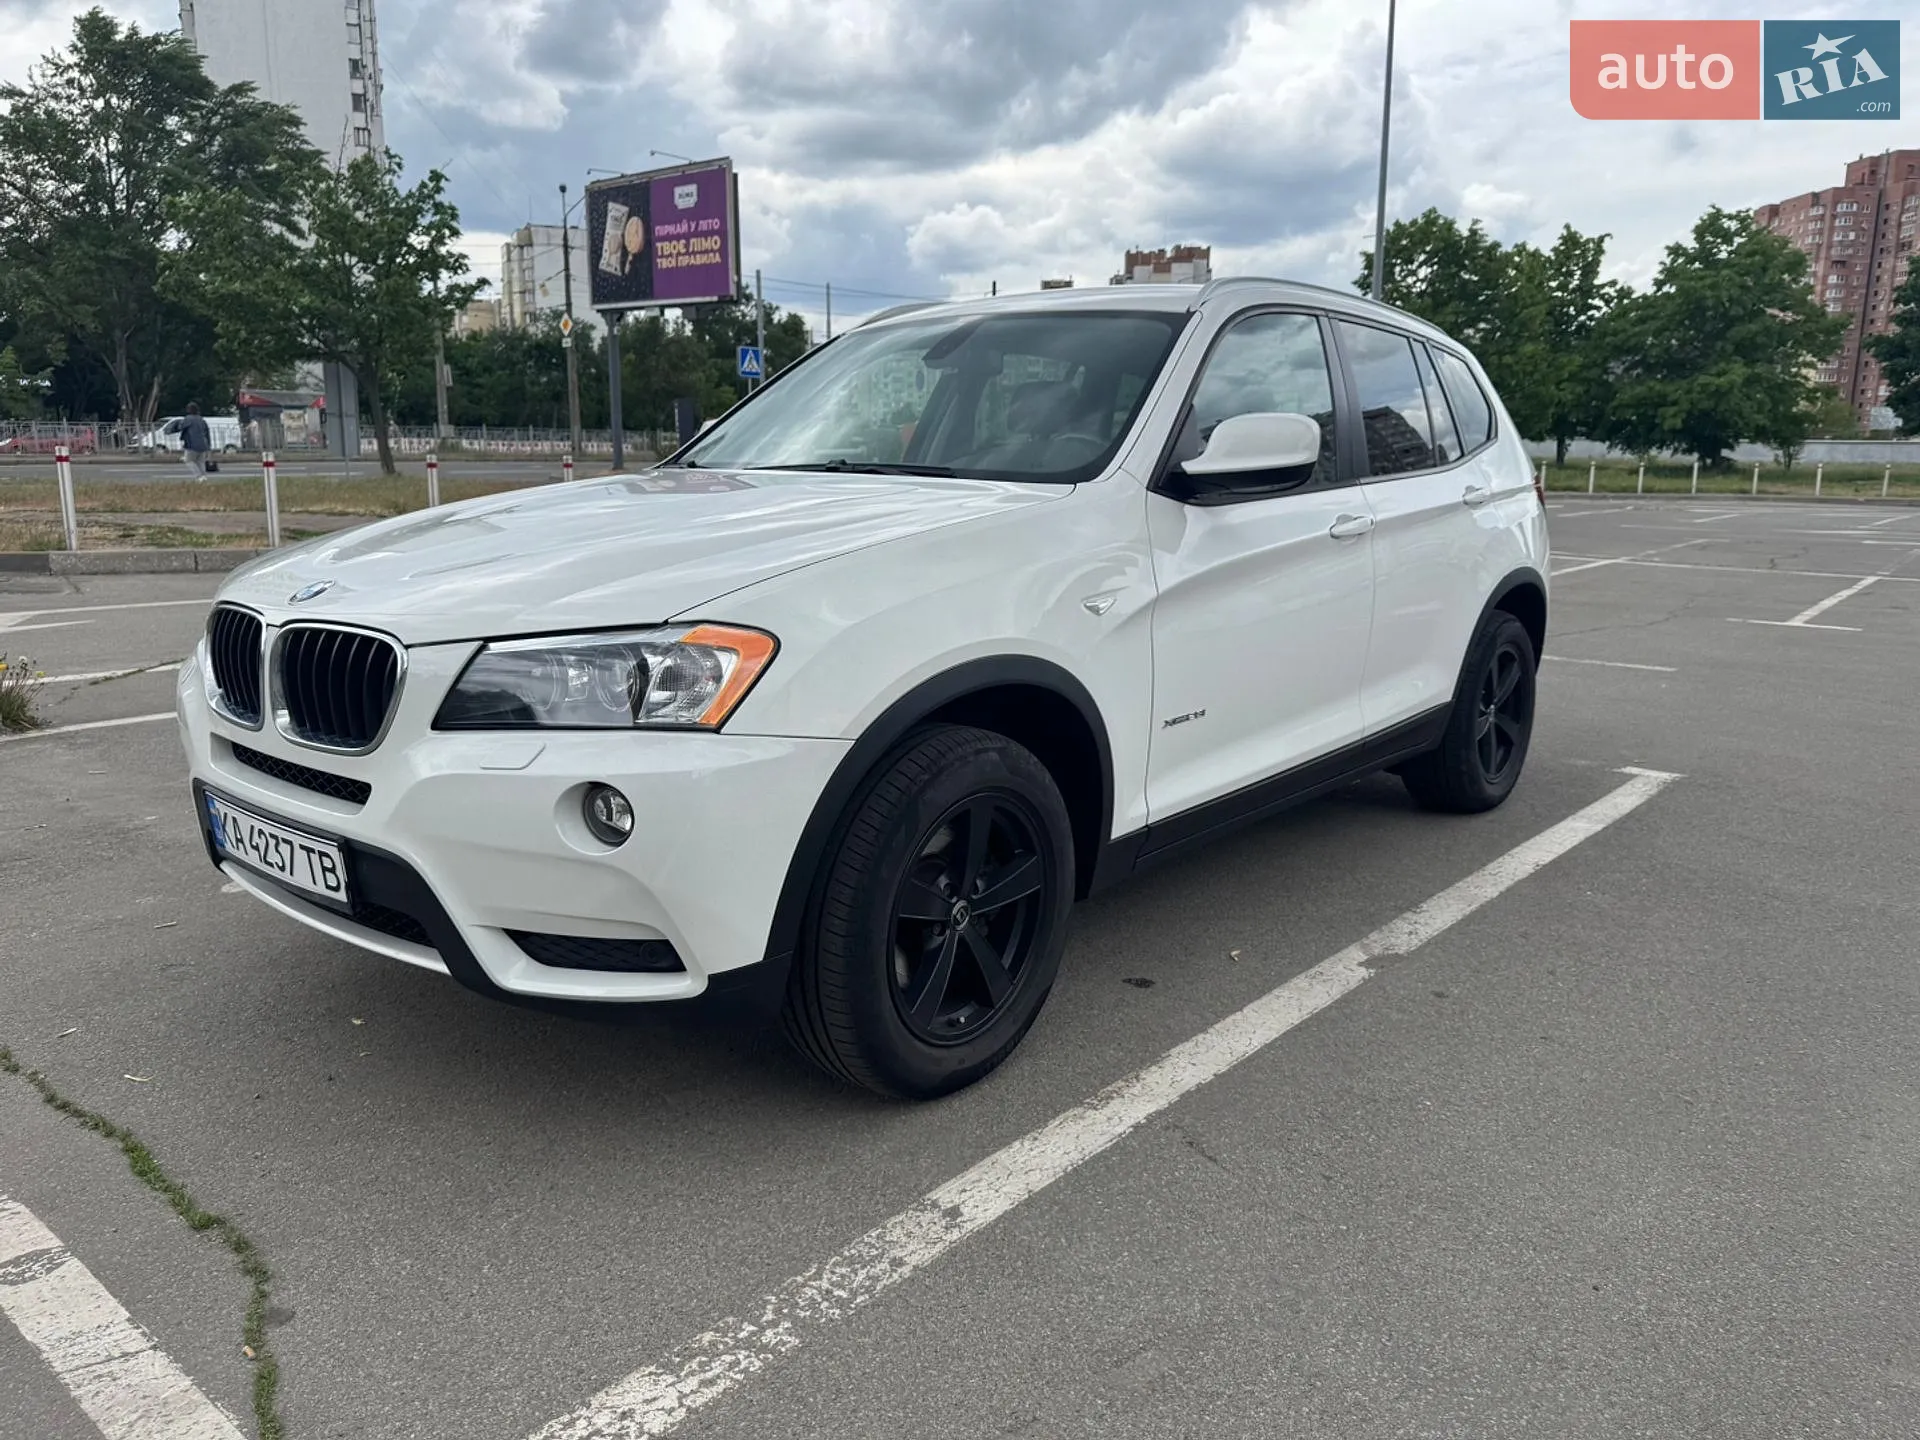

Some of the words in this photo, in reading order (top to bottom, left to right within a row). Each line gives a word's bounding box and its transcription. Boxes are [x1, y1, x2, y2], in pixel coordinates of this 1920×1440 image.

[689, 220, 696, 232] У
[698, 218, 720, 231] ЛІТО
[655, 239, 687, 256] ТВОЄ
[689, 235, 721, 253] ЛІМО
[678, 252, 721, 267] ПРАВИЛА
[217, 808, 249, 856] KA
[249, 824, 294, 877] 4237
[298, 843, 341, 893] TB
